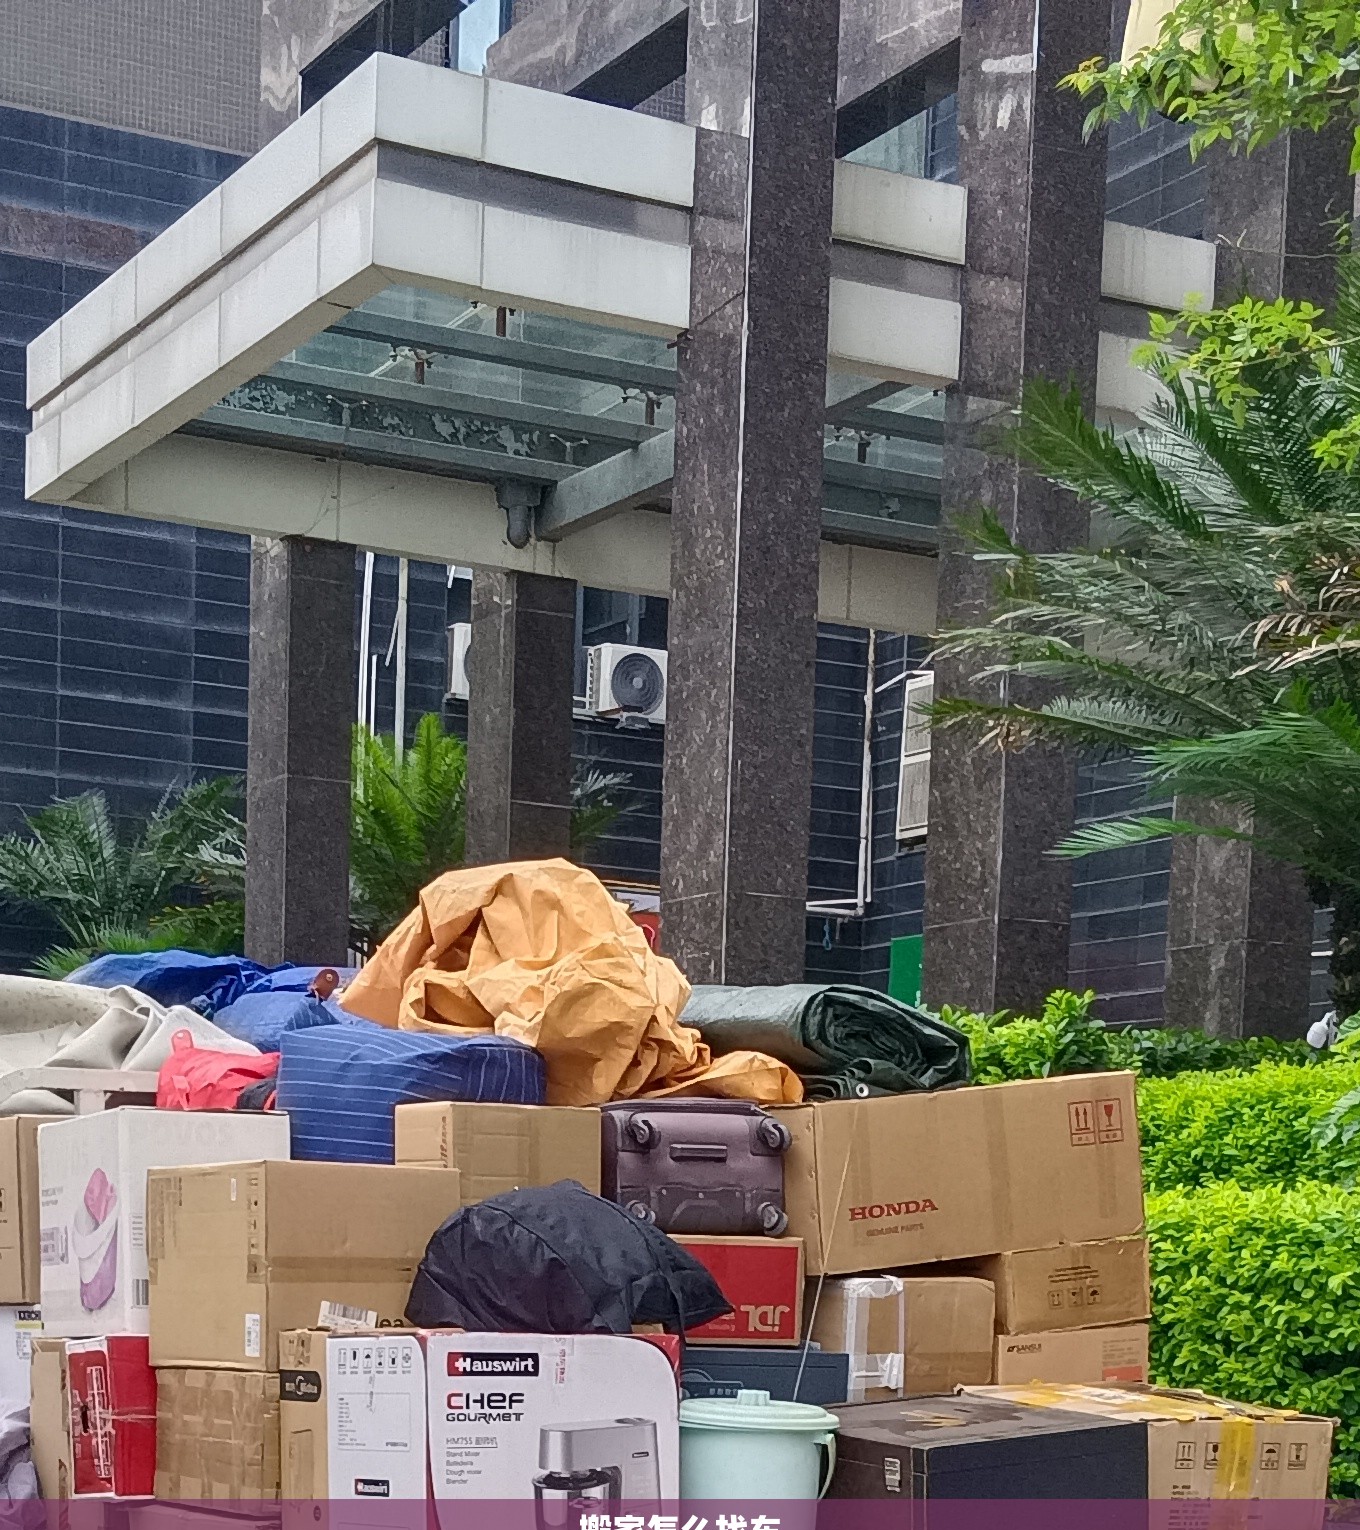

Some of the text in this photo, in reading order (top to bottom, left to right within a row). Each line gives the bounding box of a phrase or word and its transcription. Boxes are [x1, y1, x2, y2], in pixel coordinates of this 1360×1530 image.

[848, 1198, 939, 1221] HONDA
[866, 1222, 924, 1237] GENUINE PARTS
[454, 1357, 535, 1373] Hauswirt
